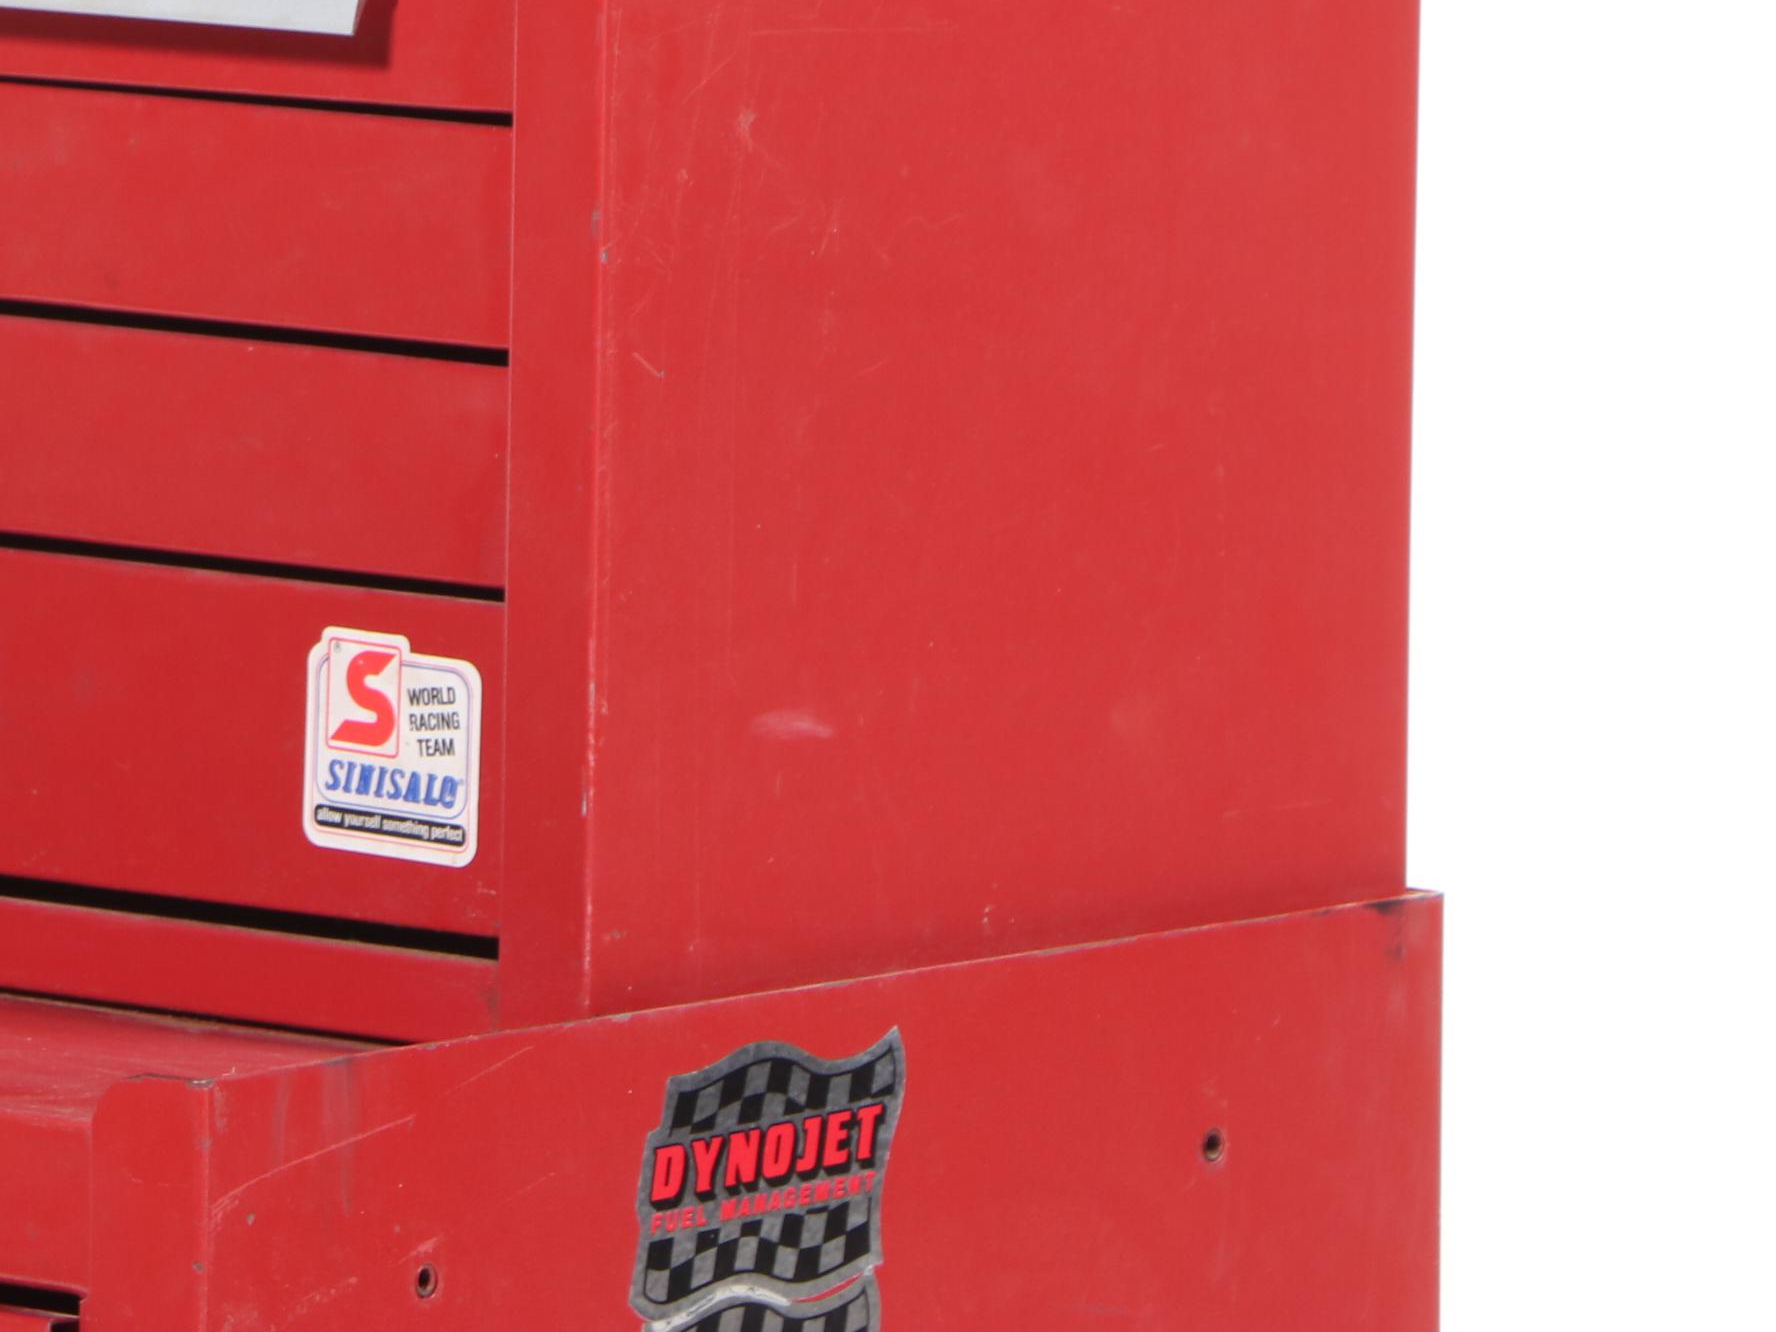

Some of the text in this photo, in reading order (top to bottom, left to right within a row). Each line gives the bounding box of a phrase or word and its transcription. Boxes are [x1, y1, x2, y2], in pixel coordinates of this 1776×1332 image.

[407, 686, 456, 707] WORLD
[409, 712, 460, 732] RACING
[416, 737, 455, 758] TEAM
[325, 759, 459, 809] SINISALO
[343, 813, 382, 828] yourself
[649, 1103, 886, 1210] DYNOJET
[651, 1171, 876, 1235] FUEL MANAGEMENT
